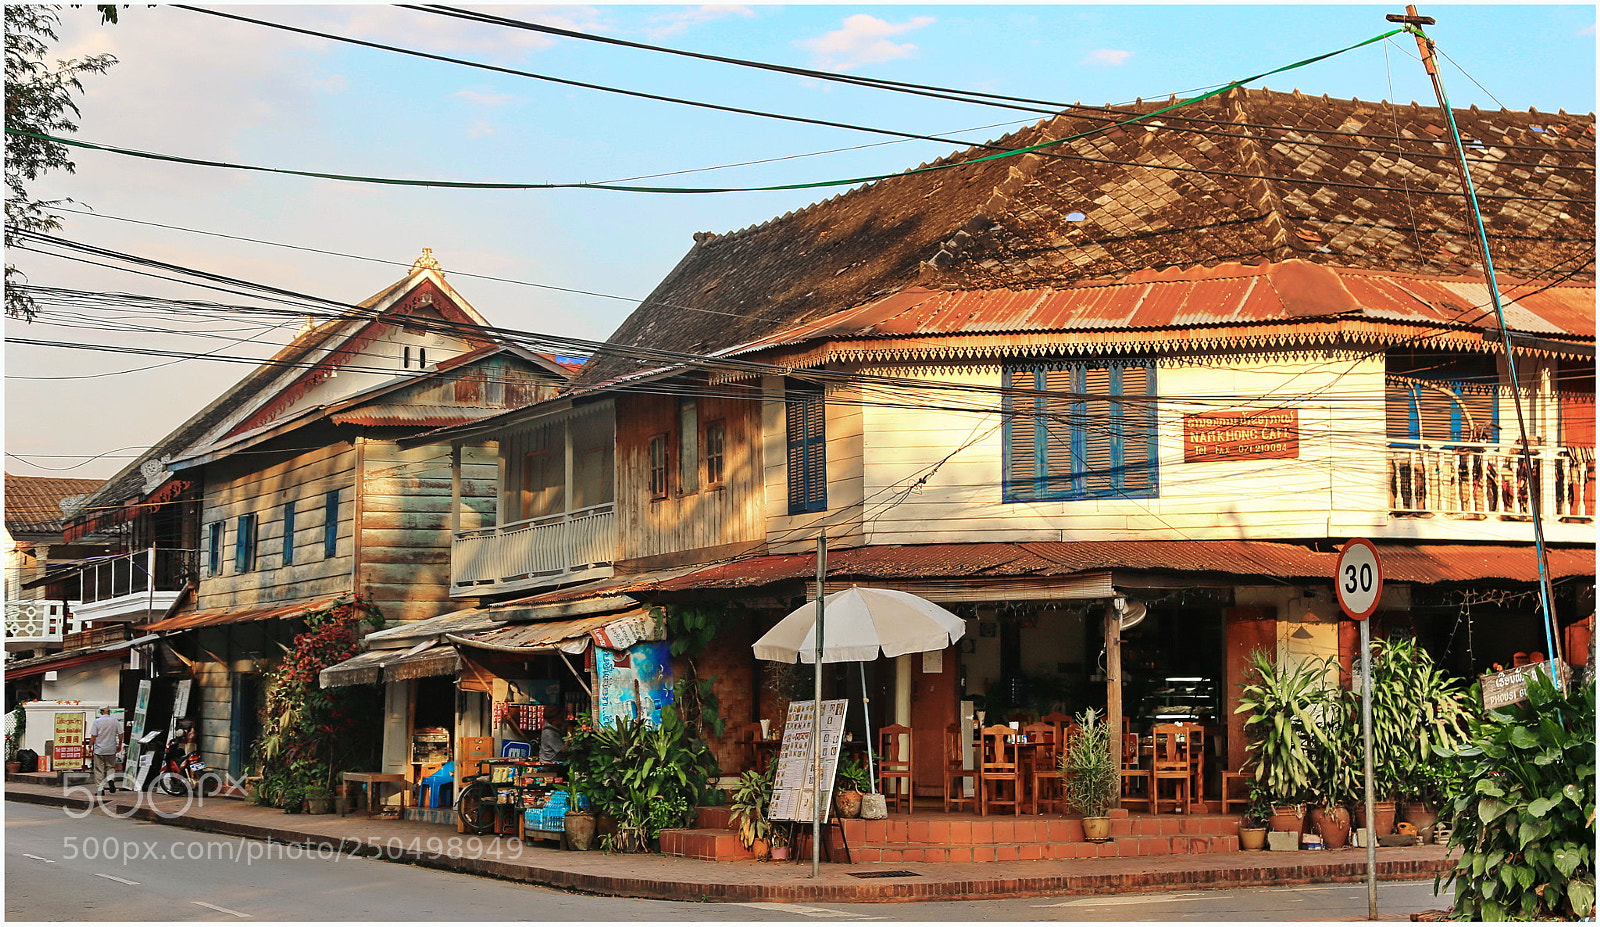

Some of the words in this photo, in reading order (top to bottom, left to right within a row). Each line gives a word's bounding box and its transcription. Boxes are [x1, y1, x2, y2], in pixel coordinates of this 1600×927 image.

[1194, 445, 1207, 455] Tel
[1345, 563, 1372, 593] 30
[1489, 690, 1517, 705] PHOUSI
